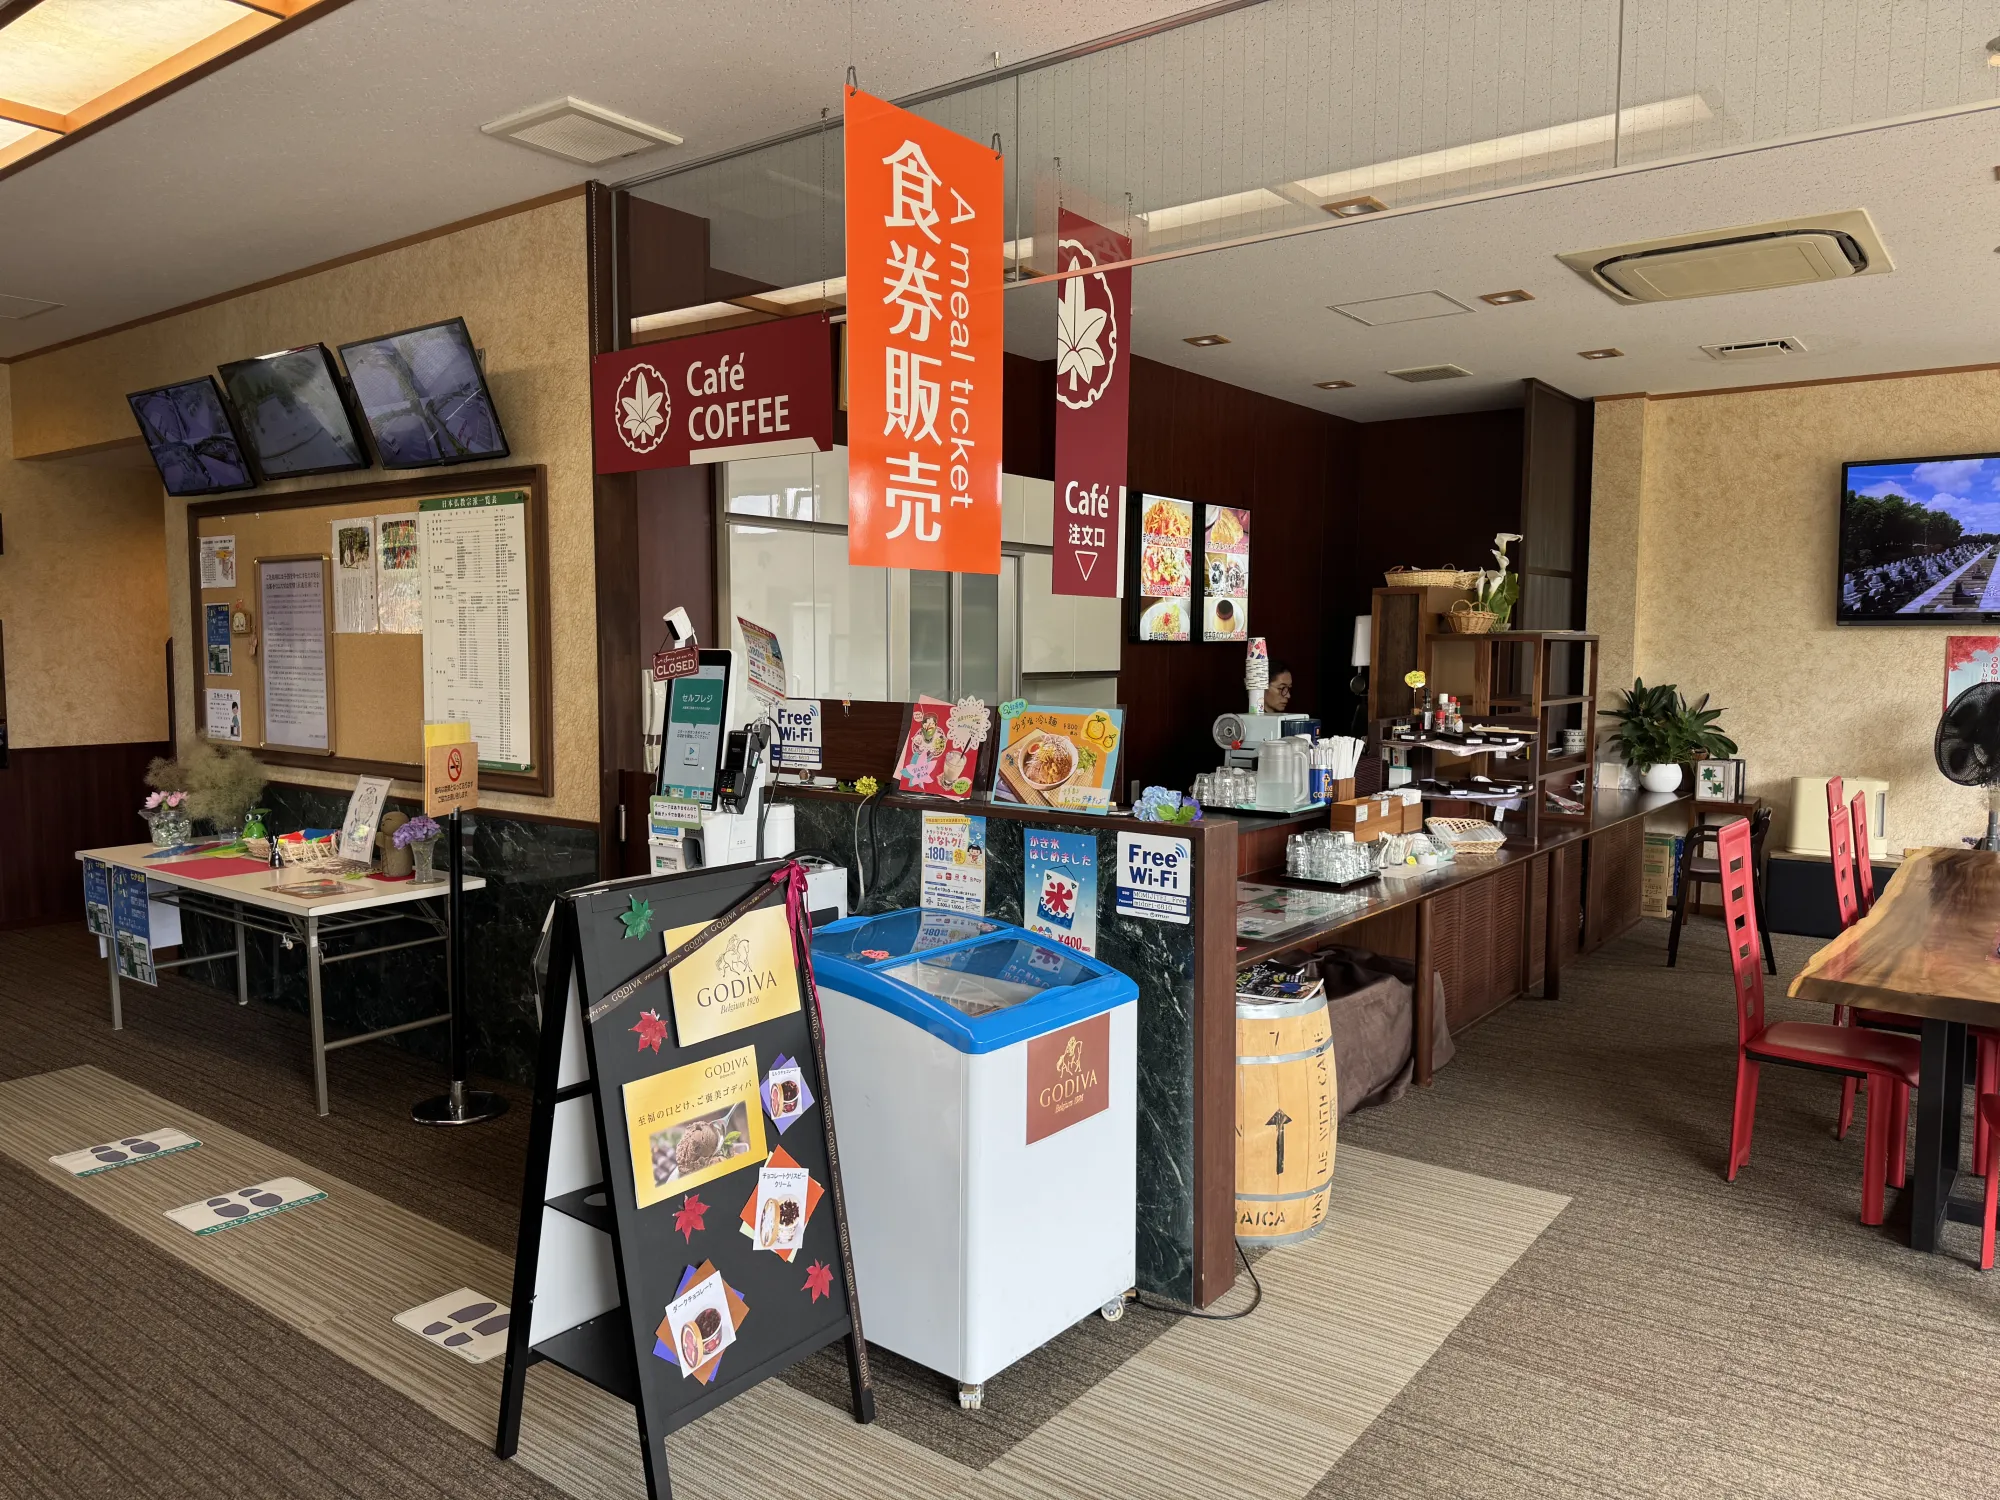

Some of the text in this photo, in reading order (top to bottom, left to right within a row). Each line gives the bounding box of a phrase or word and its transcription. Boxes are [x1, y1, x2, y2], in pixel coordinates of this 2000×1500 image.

[882, 139, 943, 542] 食券販売
[950, 187, 976, 509] A meal ticket
[686, 352, 745, 397] Café
[688, 395, 790, 442] COFFEE
[1065, 480, 1109, 518] Café
[1068, 524, 1105, 547] 注文口
[656, 659, 695, 676] CLOSED
[682, 694, 713, 704] セルフレジ
[777, 708, 812, 726] Free
[781, 726, 813, 743] Wi-Fi
[927, 834, 961, 848] かなトク!
[1029, 836, 1060, 849] かき氷
[928, 846, 945, 861] 180
[1029, 848, 1092, 866] はじめました
[1128, 843, 1178, 868] Free
[1128, 865, 1178, 889] Wi-Fi
[1045, 882, 1074, 914] 氷
[710, 911, 738, 932] GODIVA
[684, 931, 709, 952] GODIVA
[611, 979, 643, 1002] GODIVA
[697, 970, 777, 1008] GODIVA
[720, 996, 761, 1015] Belgium 1926
[1269, 1031, 1279, 1046] 7
[704, 1055, 749, 1078] GODIVA
[1040, 1069, 1098, 1108] GODIVA
[638, 1080, 752, 1127] 至福の口どけ、ご褒美ゴディバ
[762, 1172, 807, 1180] チョコレートクリスピー
[1235, 1211, 1286, 1227] AICA
[672, 1281, 713, 1313] ダークチョコレート
[859, 1352, 870, 1388] GODIVA
